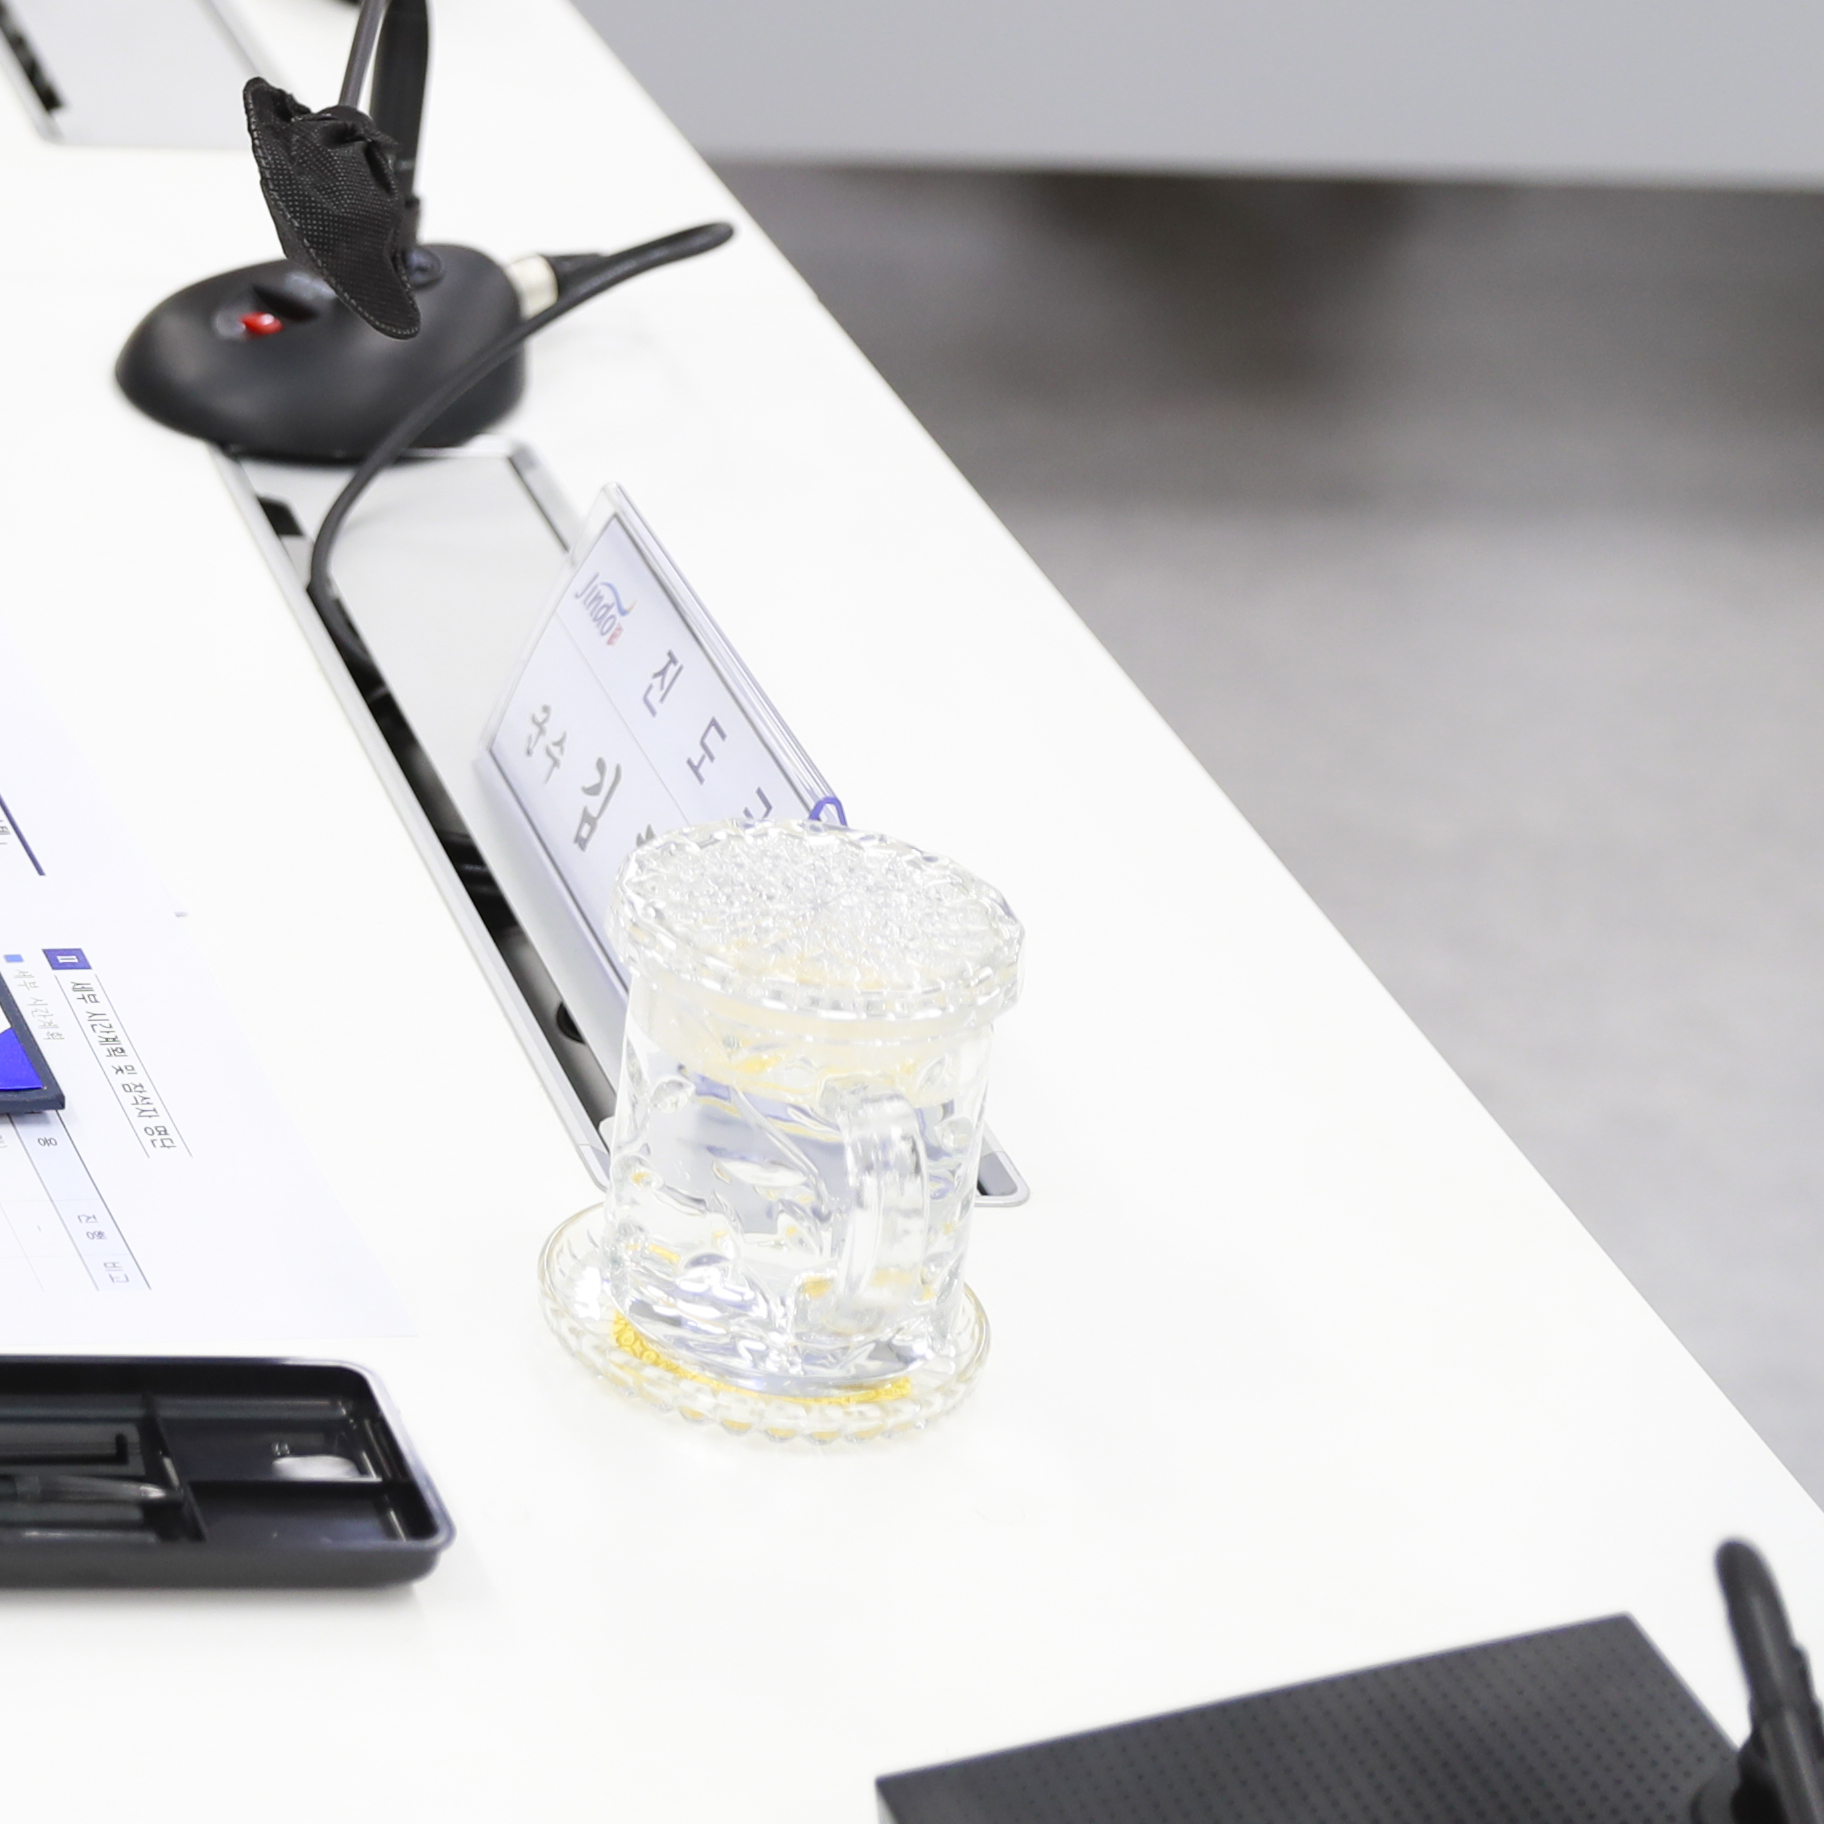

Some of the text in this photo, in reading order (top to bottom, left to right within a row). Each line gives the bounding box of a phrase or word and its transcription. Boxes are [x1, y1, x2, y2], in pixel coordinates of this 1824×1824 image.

[13, 969, 65, 1041] 세부 시간계획
[70, 981, 99, 1004] 세부
[86, 1010, 128, 1058] 시간계획
[112, 1064, 137, 1075] 및
[144, 1125, 176, 1149] 명단
[103, 1261, 130, 1284] 비고
